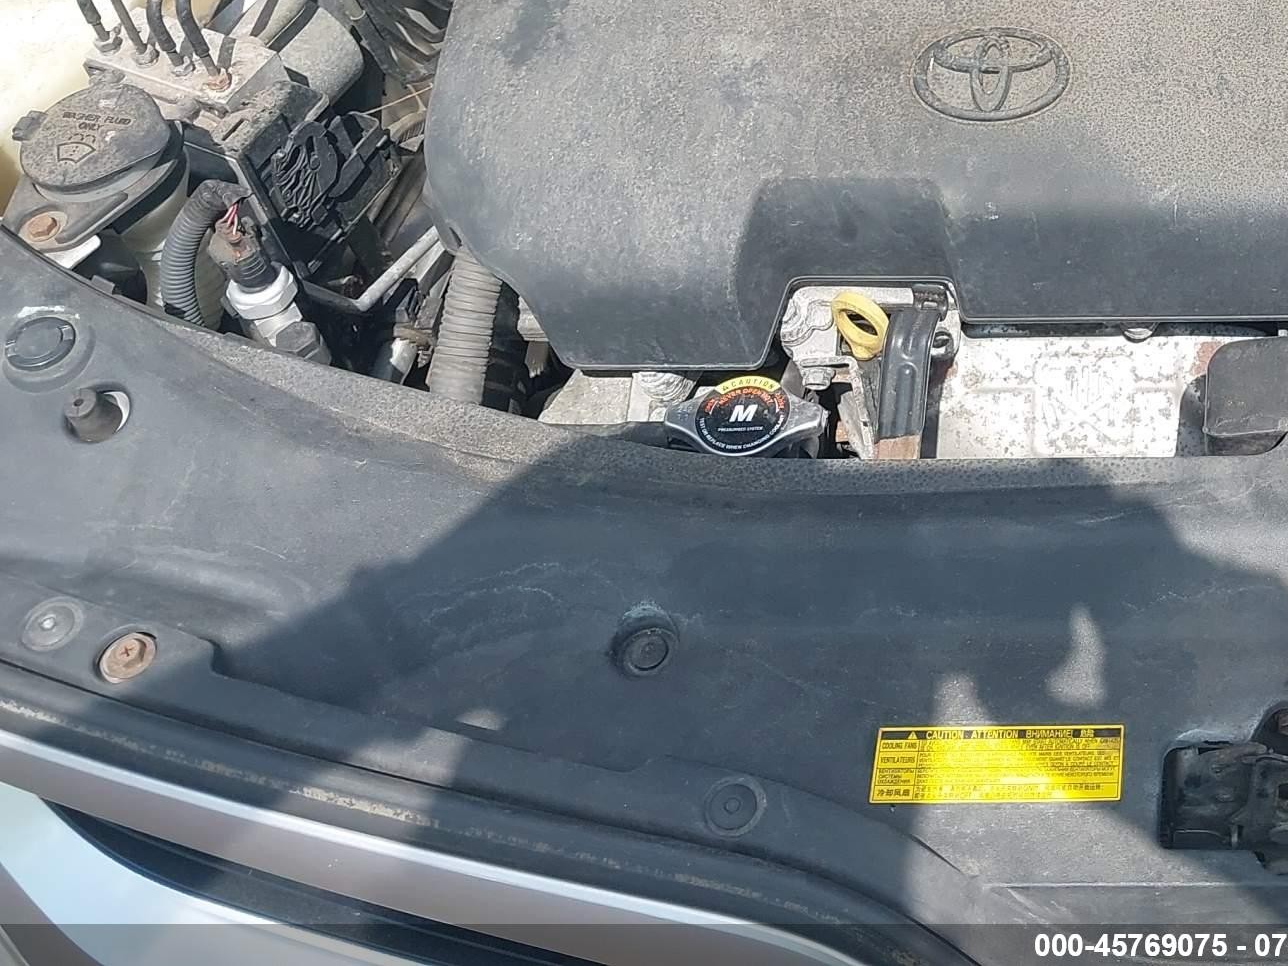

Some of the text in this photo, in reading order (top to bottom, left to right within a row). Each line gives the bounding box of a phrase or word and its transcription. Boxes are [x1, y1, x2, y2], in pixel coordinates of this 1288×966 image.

[62, 110, 132, 126] WASHER FLUID
[78, 121, 105, 131] ONLY
[731, 378, 775, 390] CAUTION
[728, 404, 758, 422] M
[925, 728, 1019, 740] CAUTION ATTENTION
[881, 742, 903, 750] COOLING
[904, 742, 918, 750] FANS
[880, 756, 915, 764] VENTILATEURS
